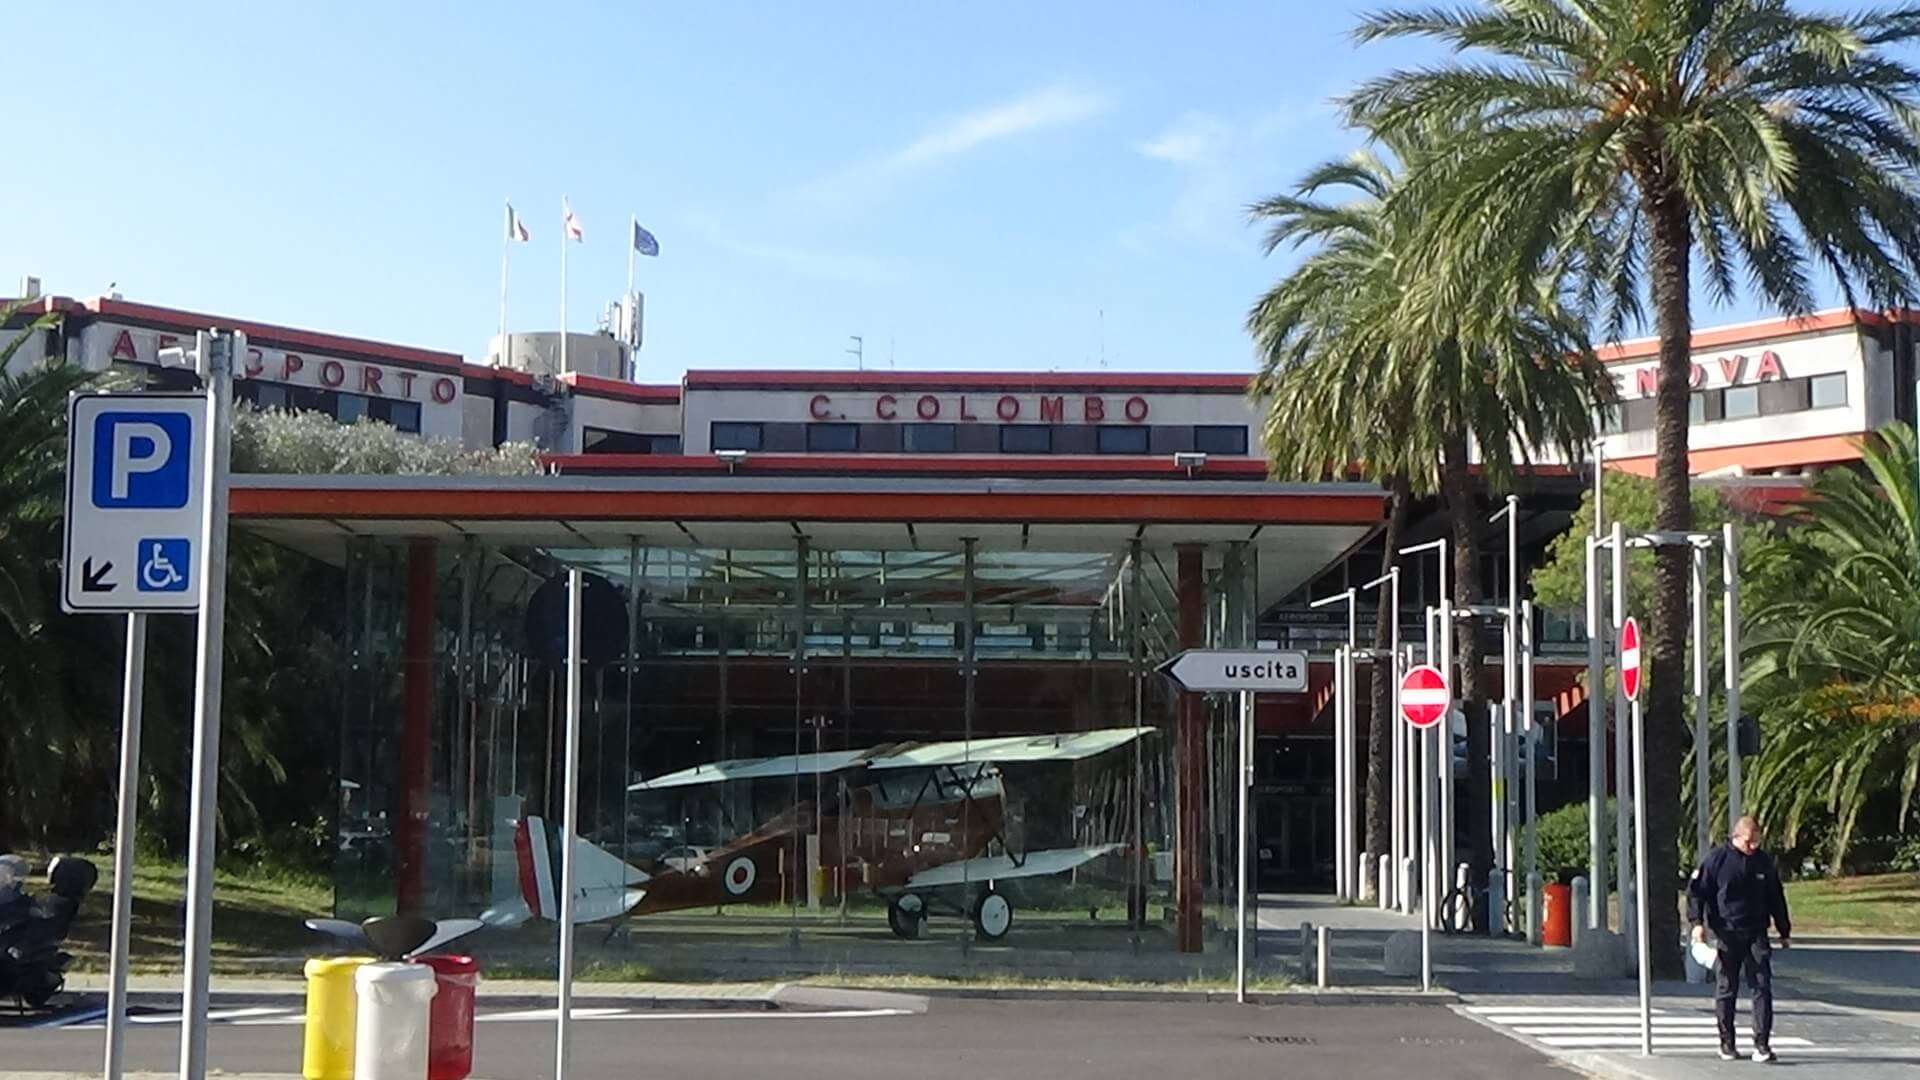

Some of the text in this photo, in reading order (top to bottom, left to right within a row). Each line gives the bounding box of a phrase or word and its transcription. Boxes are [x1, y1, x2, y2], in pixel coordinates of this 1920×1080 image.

[111, 329, 457, 404] AEOPORTO
[809, 394, 1149, 422] C. COLOMBO
[111, 422, 171, 499] P
[1224, 660, 1297, 679] uscita
